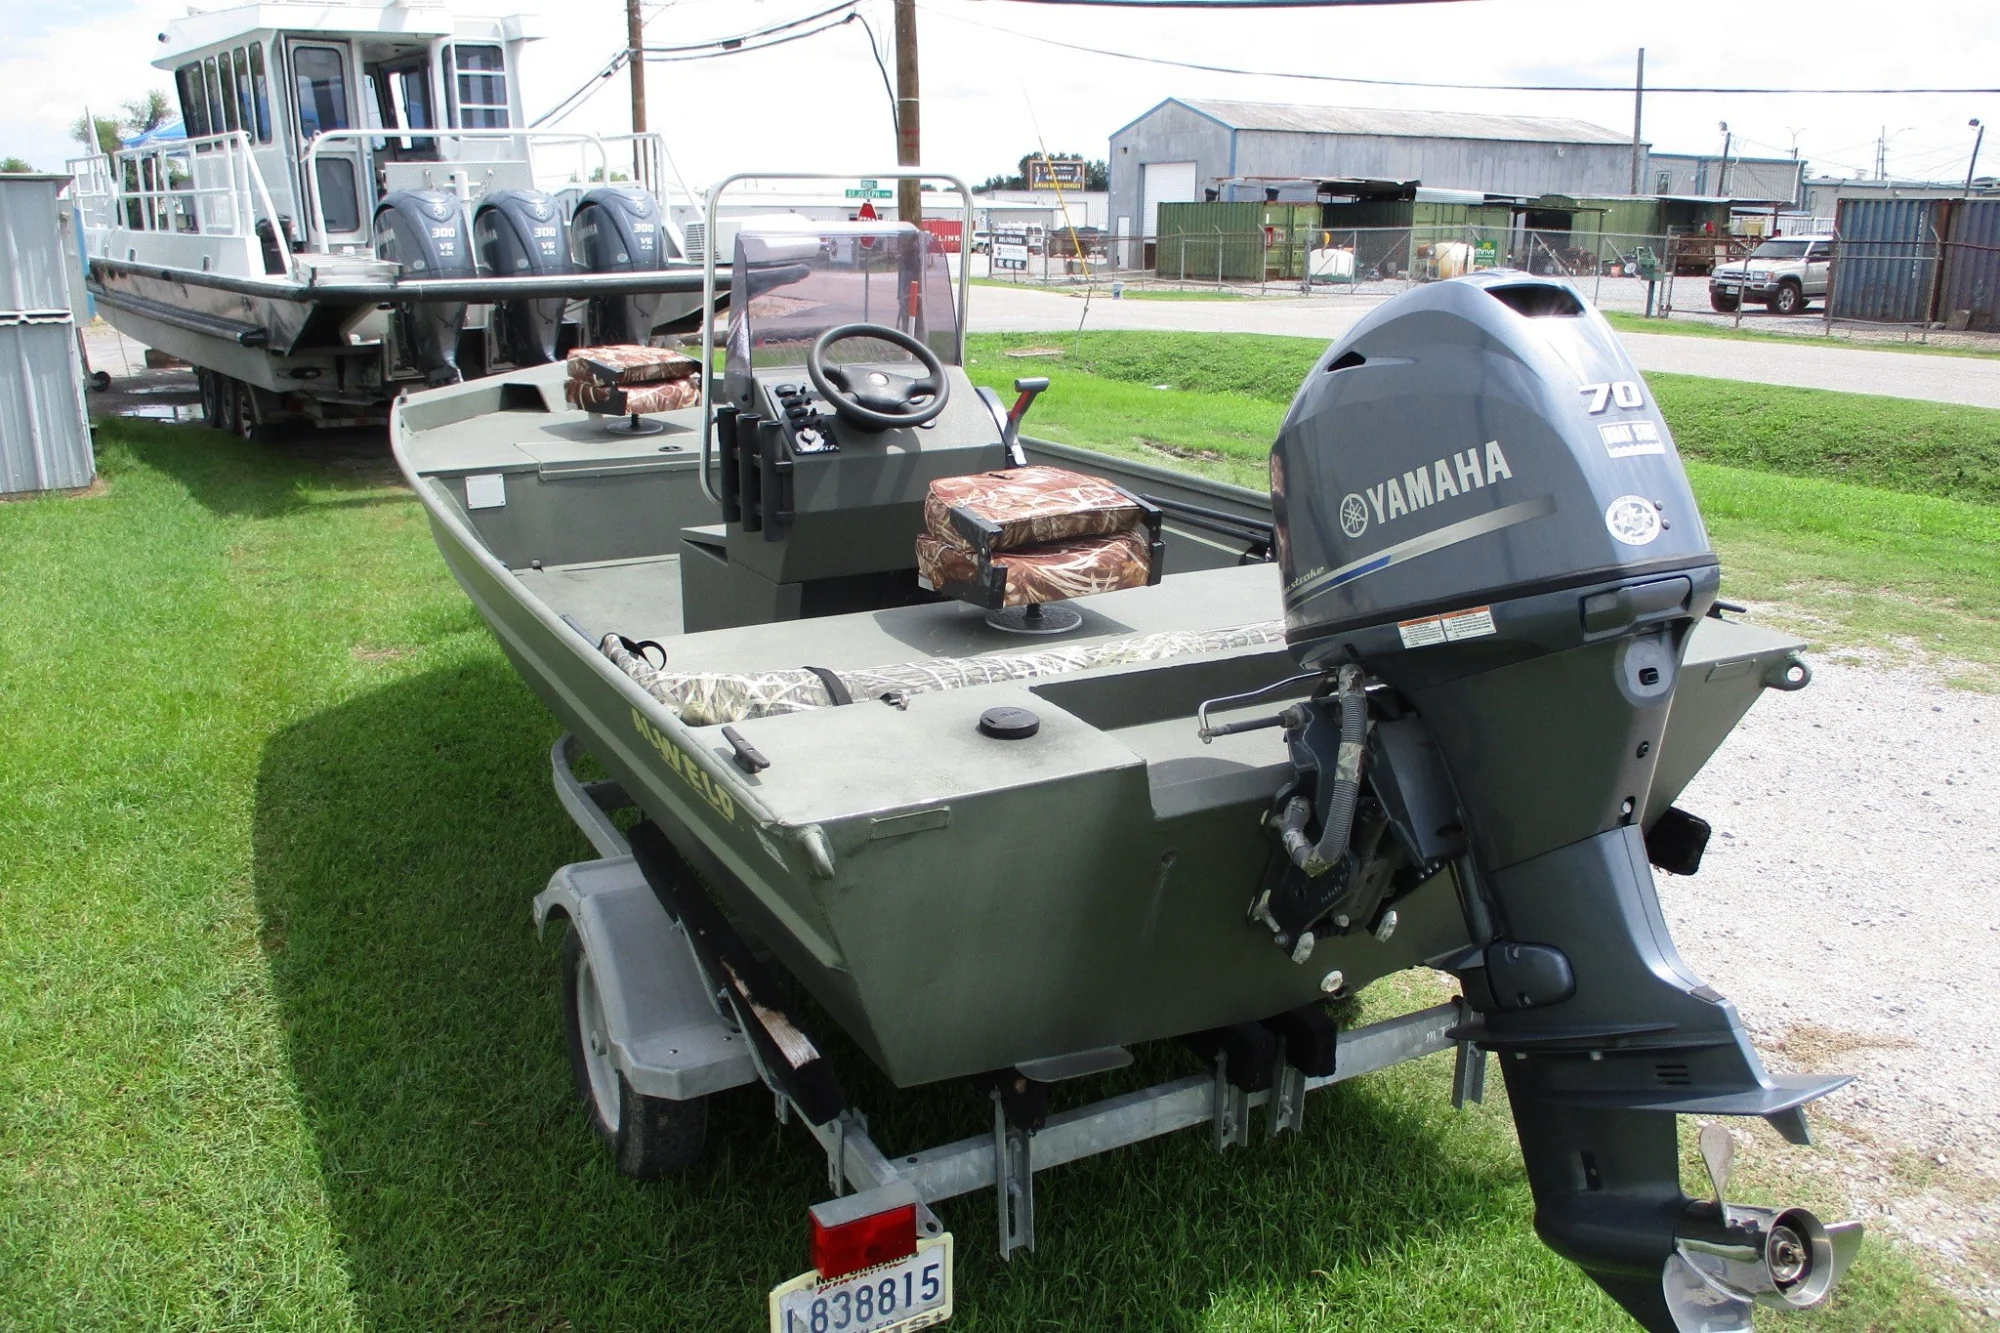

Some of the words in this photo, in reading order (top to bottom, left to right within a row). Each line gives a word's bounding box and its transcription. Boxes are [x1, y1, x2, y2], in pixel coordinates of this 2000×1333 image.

[431, 227, 456, 238] 300
[533, 227, 557, 238] 300
[633, 223, 655, 233] 300
[938, 234, 961, 242] LINE
[439, 242, 454, 250] V6
[541, 241, 555, 249] V6
[1577, 381, 1644, 414] 70
[1365, 439, 1513, 525] YAMAHA
[631, 707, 735, 820] ALWELD
